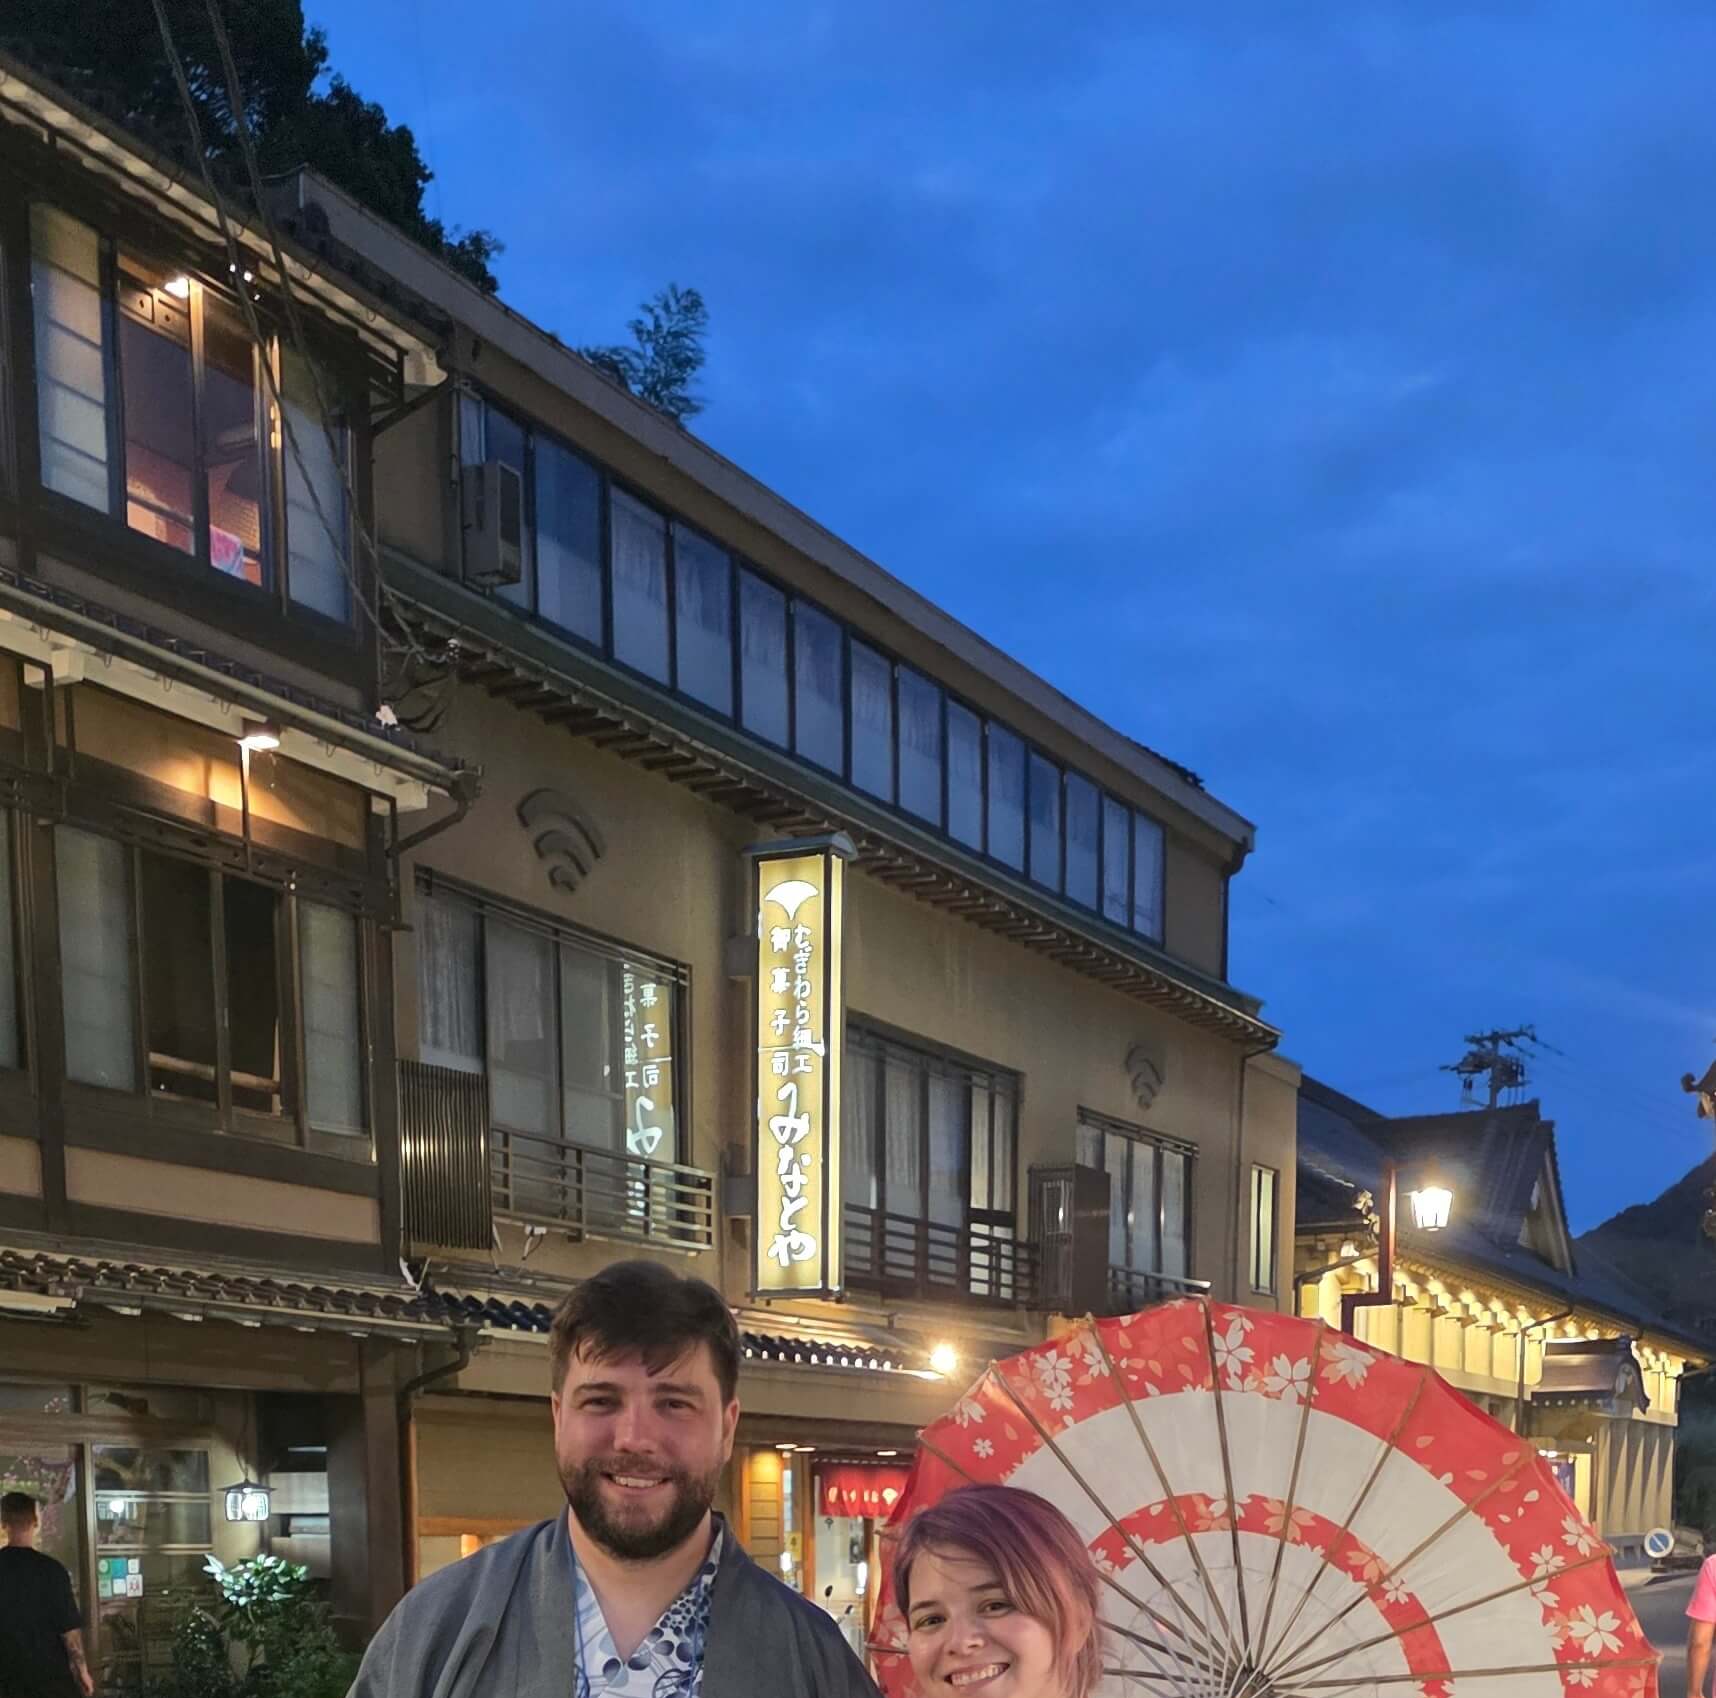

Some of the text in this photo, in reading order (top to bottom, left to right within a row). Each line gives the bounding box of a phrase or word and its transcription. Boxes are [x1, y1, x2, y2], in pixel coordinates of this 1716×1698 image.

[792, 924, 813, 1074] むぎわら細工
[768, 1082, 817, 1267] みなとや
